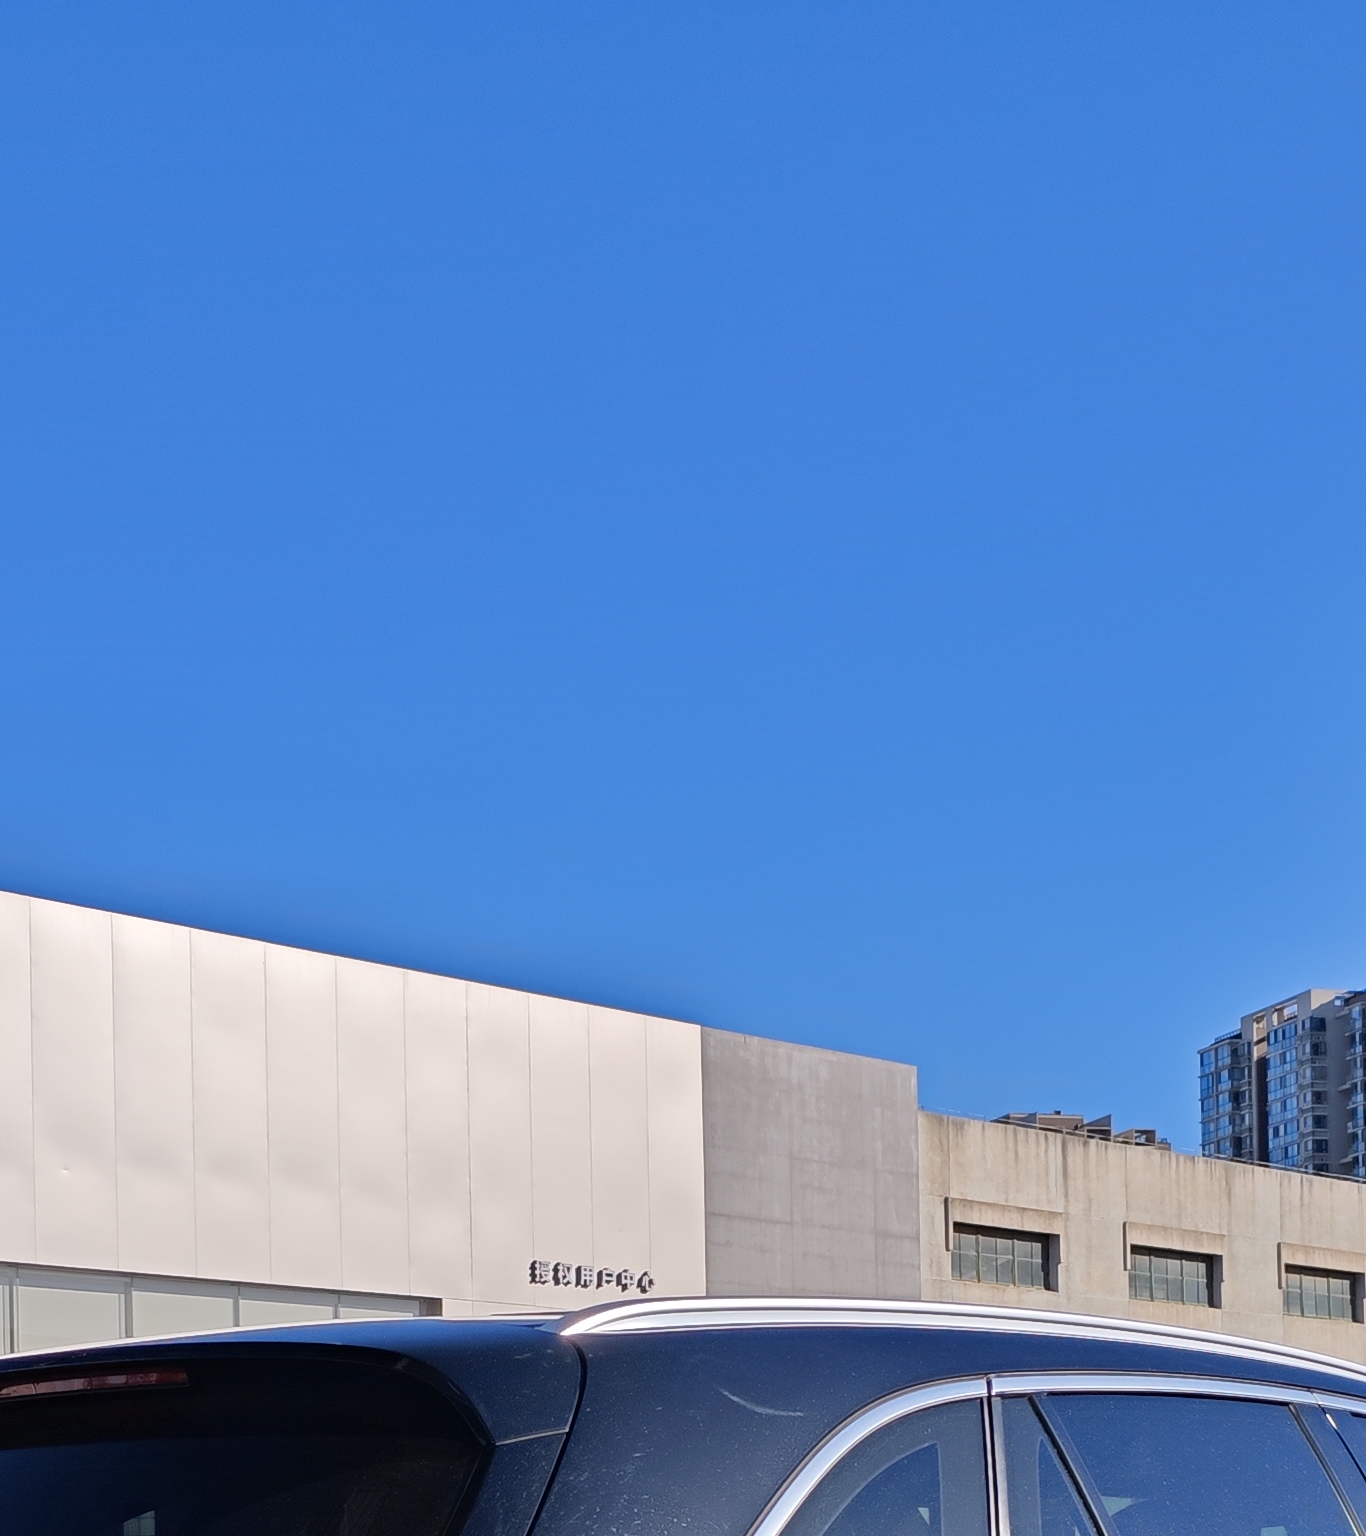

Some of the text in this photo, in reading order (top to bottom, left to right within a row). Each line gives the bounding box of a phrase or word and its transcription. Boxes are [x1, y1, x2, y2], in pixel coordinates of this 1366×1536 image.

[529, 1258, 655, 1295] 授权用户中心
